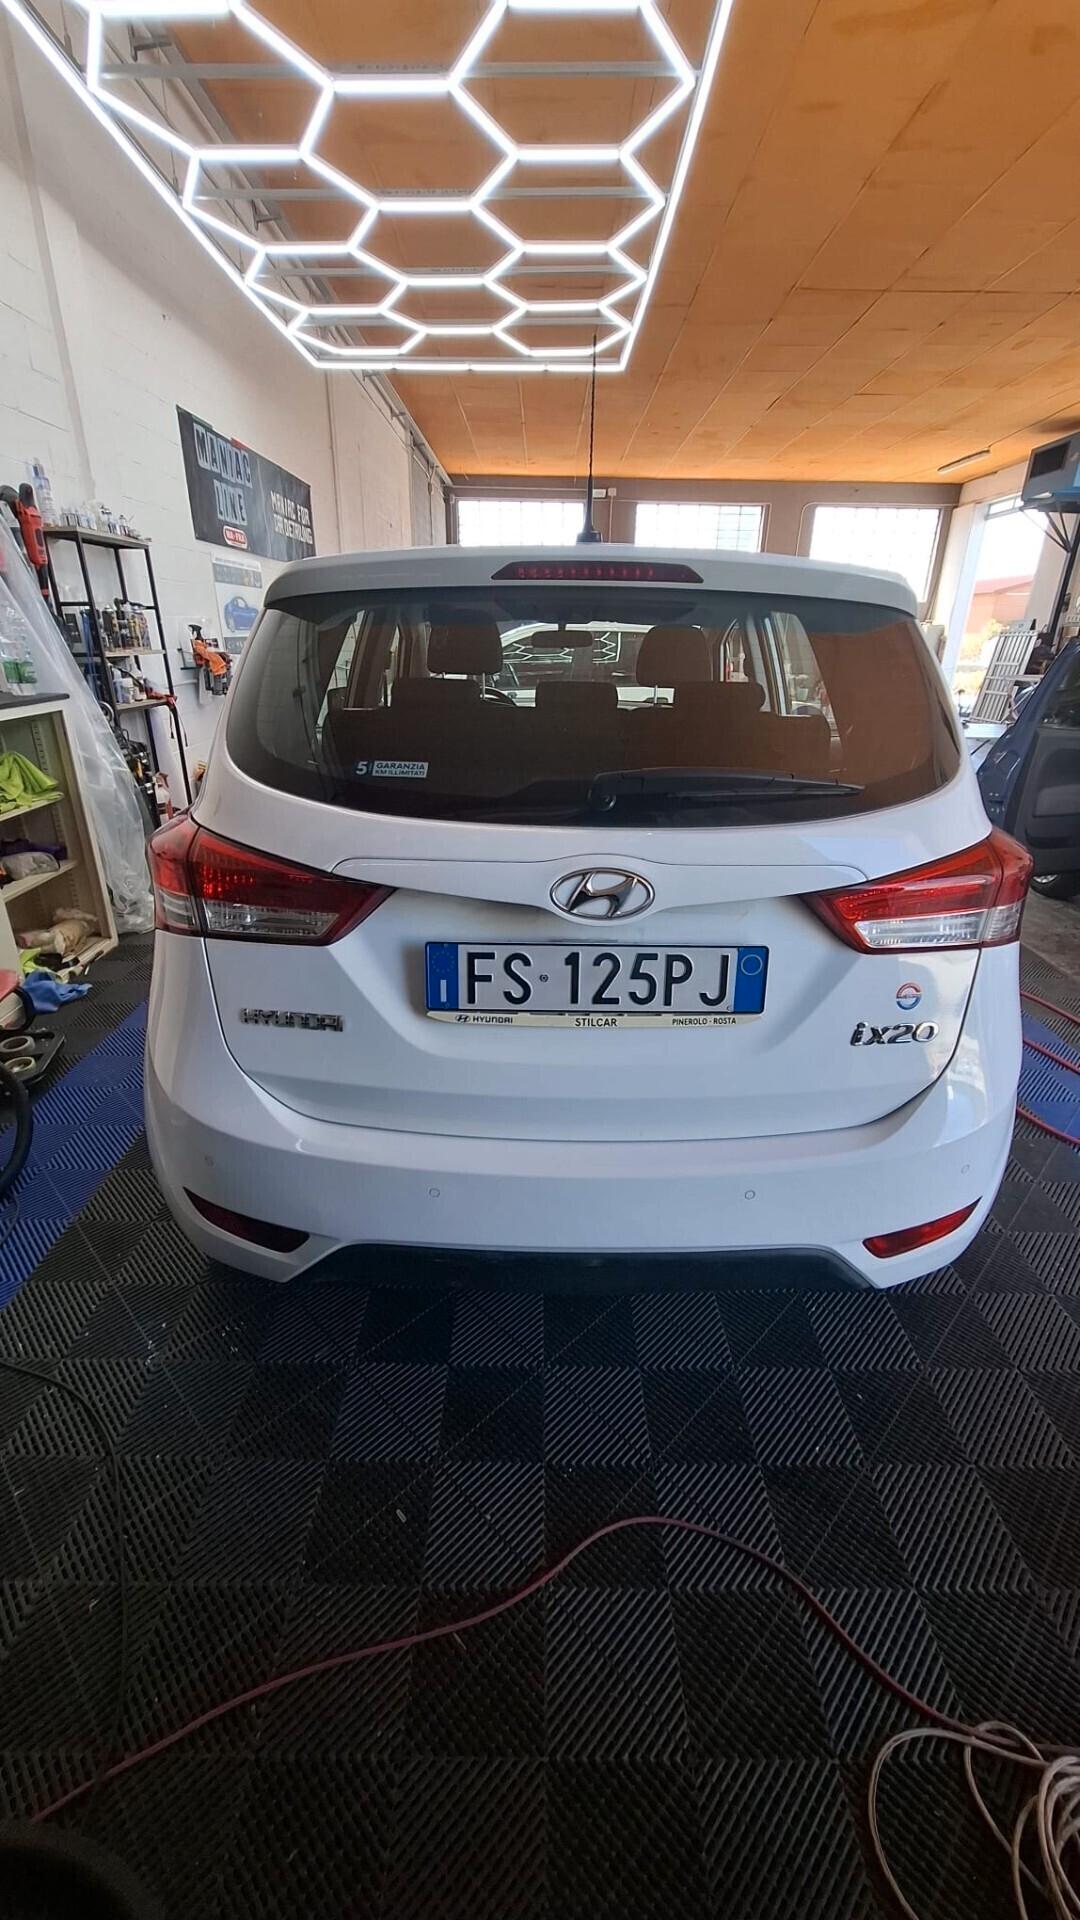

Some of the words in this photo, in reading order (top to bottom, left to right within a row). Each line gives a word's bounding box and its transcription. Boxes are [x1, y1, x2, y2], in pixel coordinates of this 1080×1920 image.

[193, 422, 252, 488] MANIAC
[213, 479, 248, 526] LINE
[296, 503, 310, 526] FOR
[355, 761, 368, 775] 5
[375, 762, 425, 770] GARANZIA
[466, 951, 532, 1005] FS
[564, 951, 730, 1006] 125PJ
[240, 1007, 344, 1033] HYUNDAI
[472, 1015, 514, 1024] HYUNDAI
[574, 1017, 618, 1027] STILCAR
[672, 1018, 707, 1026] PINEROLO
[713, 1017, 736, 1025] ROSTA
[850, 1021, 938, 1046] ix20
